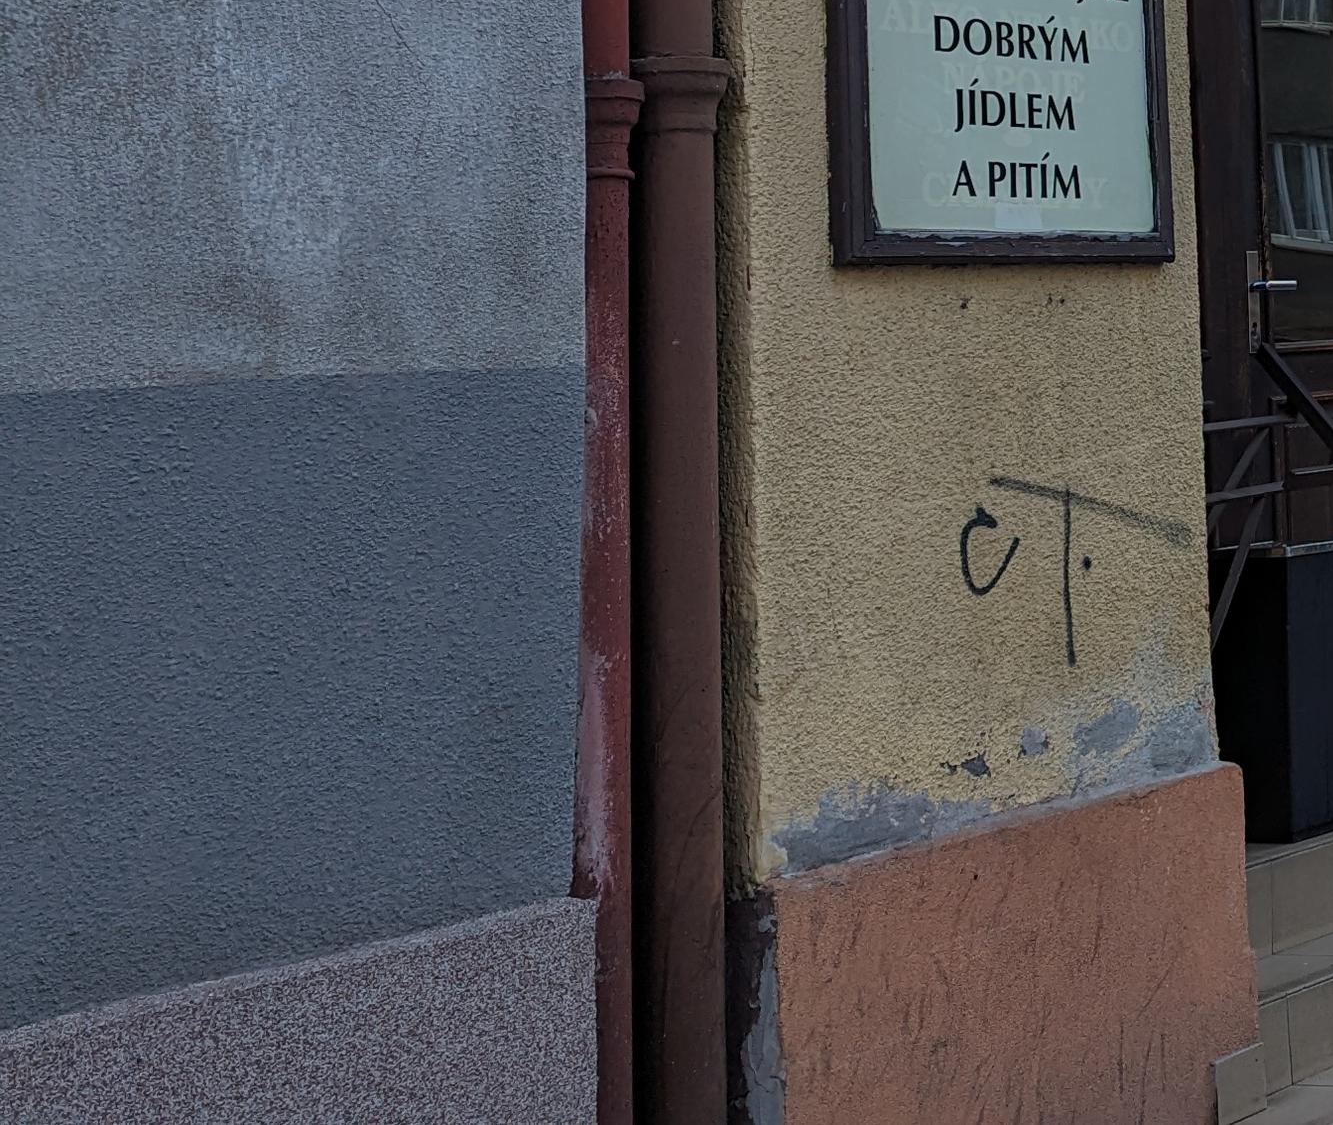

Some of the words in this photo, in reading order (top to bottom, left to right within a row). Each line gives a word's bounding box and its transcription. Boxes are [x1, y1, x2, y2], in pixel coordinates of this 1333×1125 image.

[933, 16, 1090, 64] DOBRÝM
[954, 78, 1076, 133] JÍDLEM
[952, 160, 977, 197] A
[988, 152, 1081, 200] PITÍM
